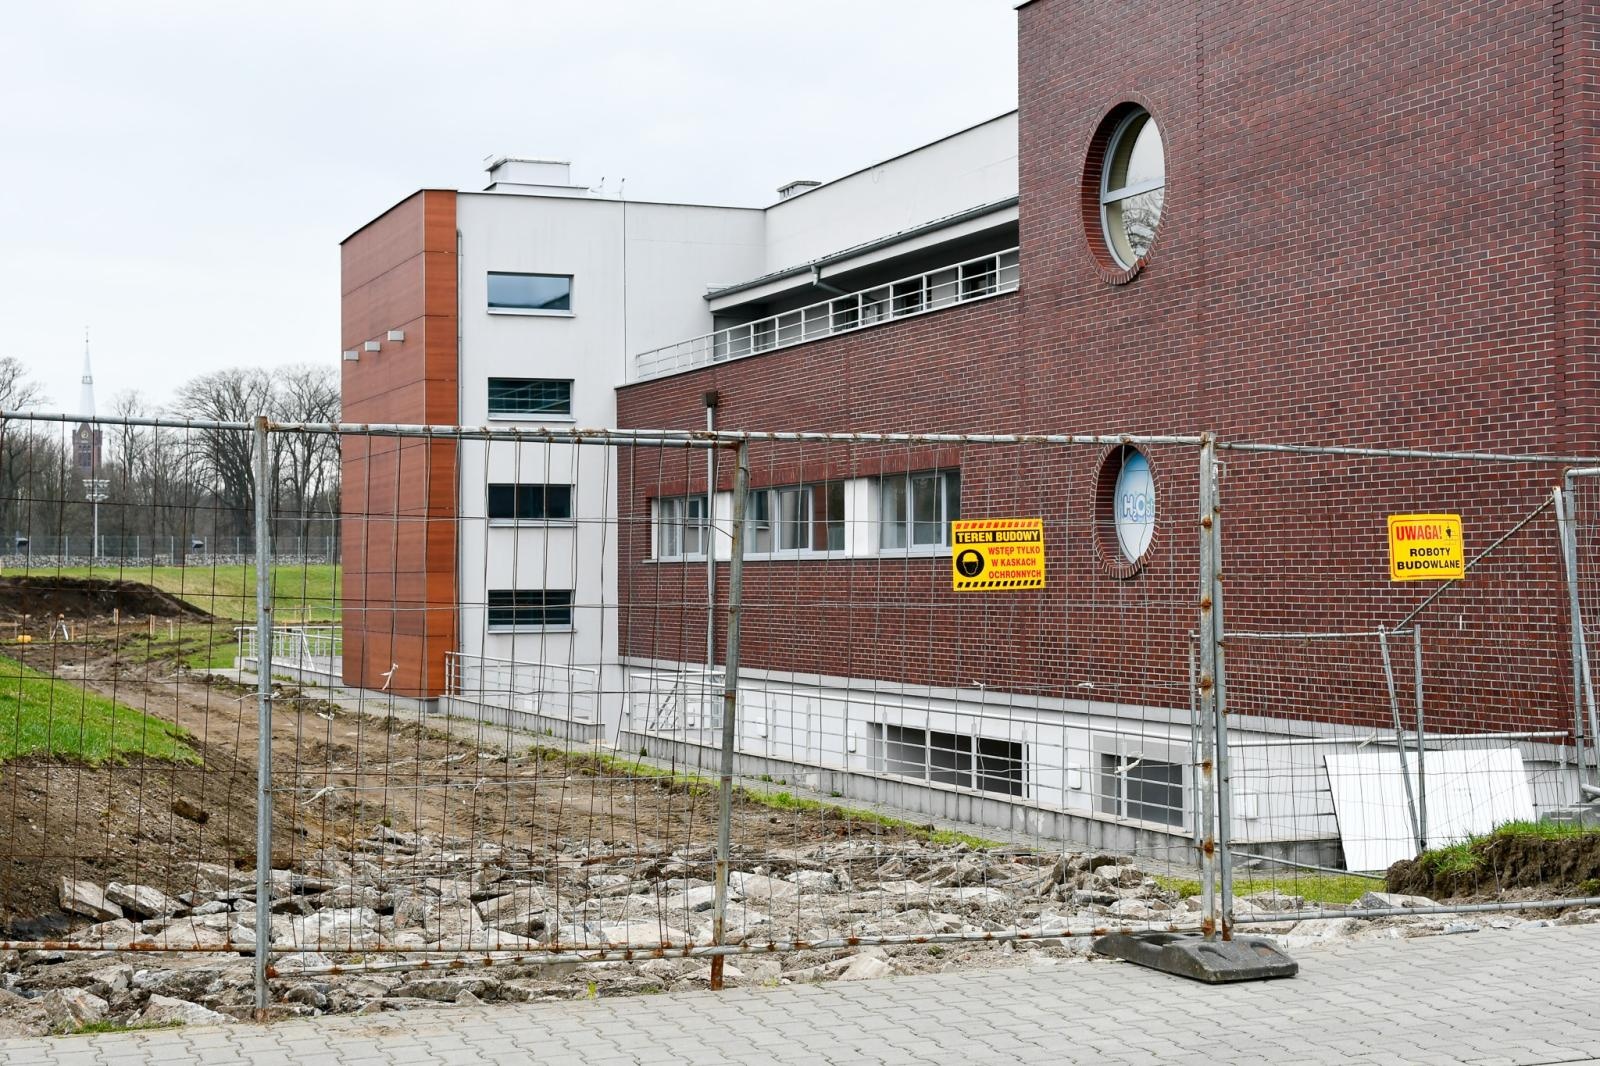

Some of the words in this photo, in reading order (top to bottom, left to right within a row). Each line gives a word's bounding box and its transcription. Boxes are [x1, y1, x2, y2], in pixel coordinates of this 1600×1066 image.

[957, 532, 992, 543] TEREN
[996, 531, 1038, 542] BUDOWY
[1396, 525, 1442, 541] UWAGA!
[988, 547, 1015, 556] WSTĘP
[1017, 546, 1040, 554] TYLKO
[1409, 547, 1451, 557] ROBOTY
[1000, 558, 1036, 567] KASKACH
[1397, 559, 1461, 570] BUDOWLANE
[988, 570, 1042, 579] OCHRONNYCH
